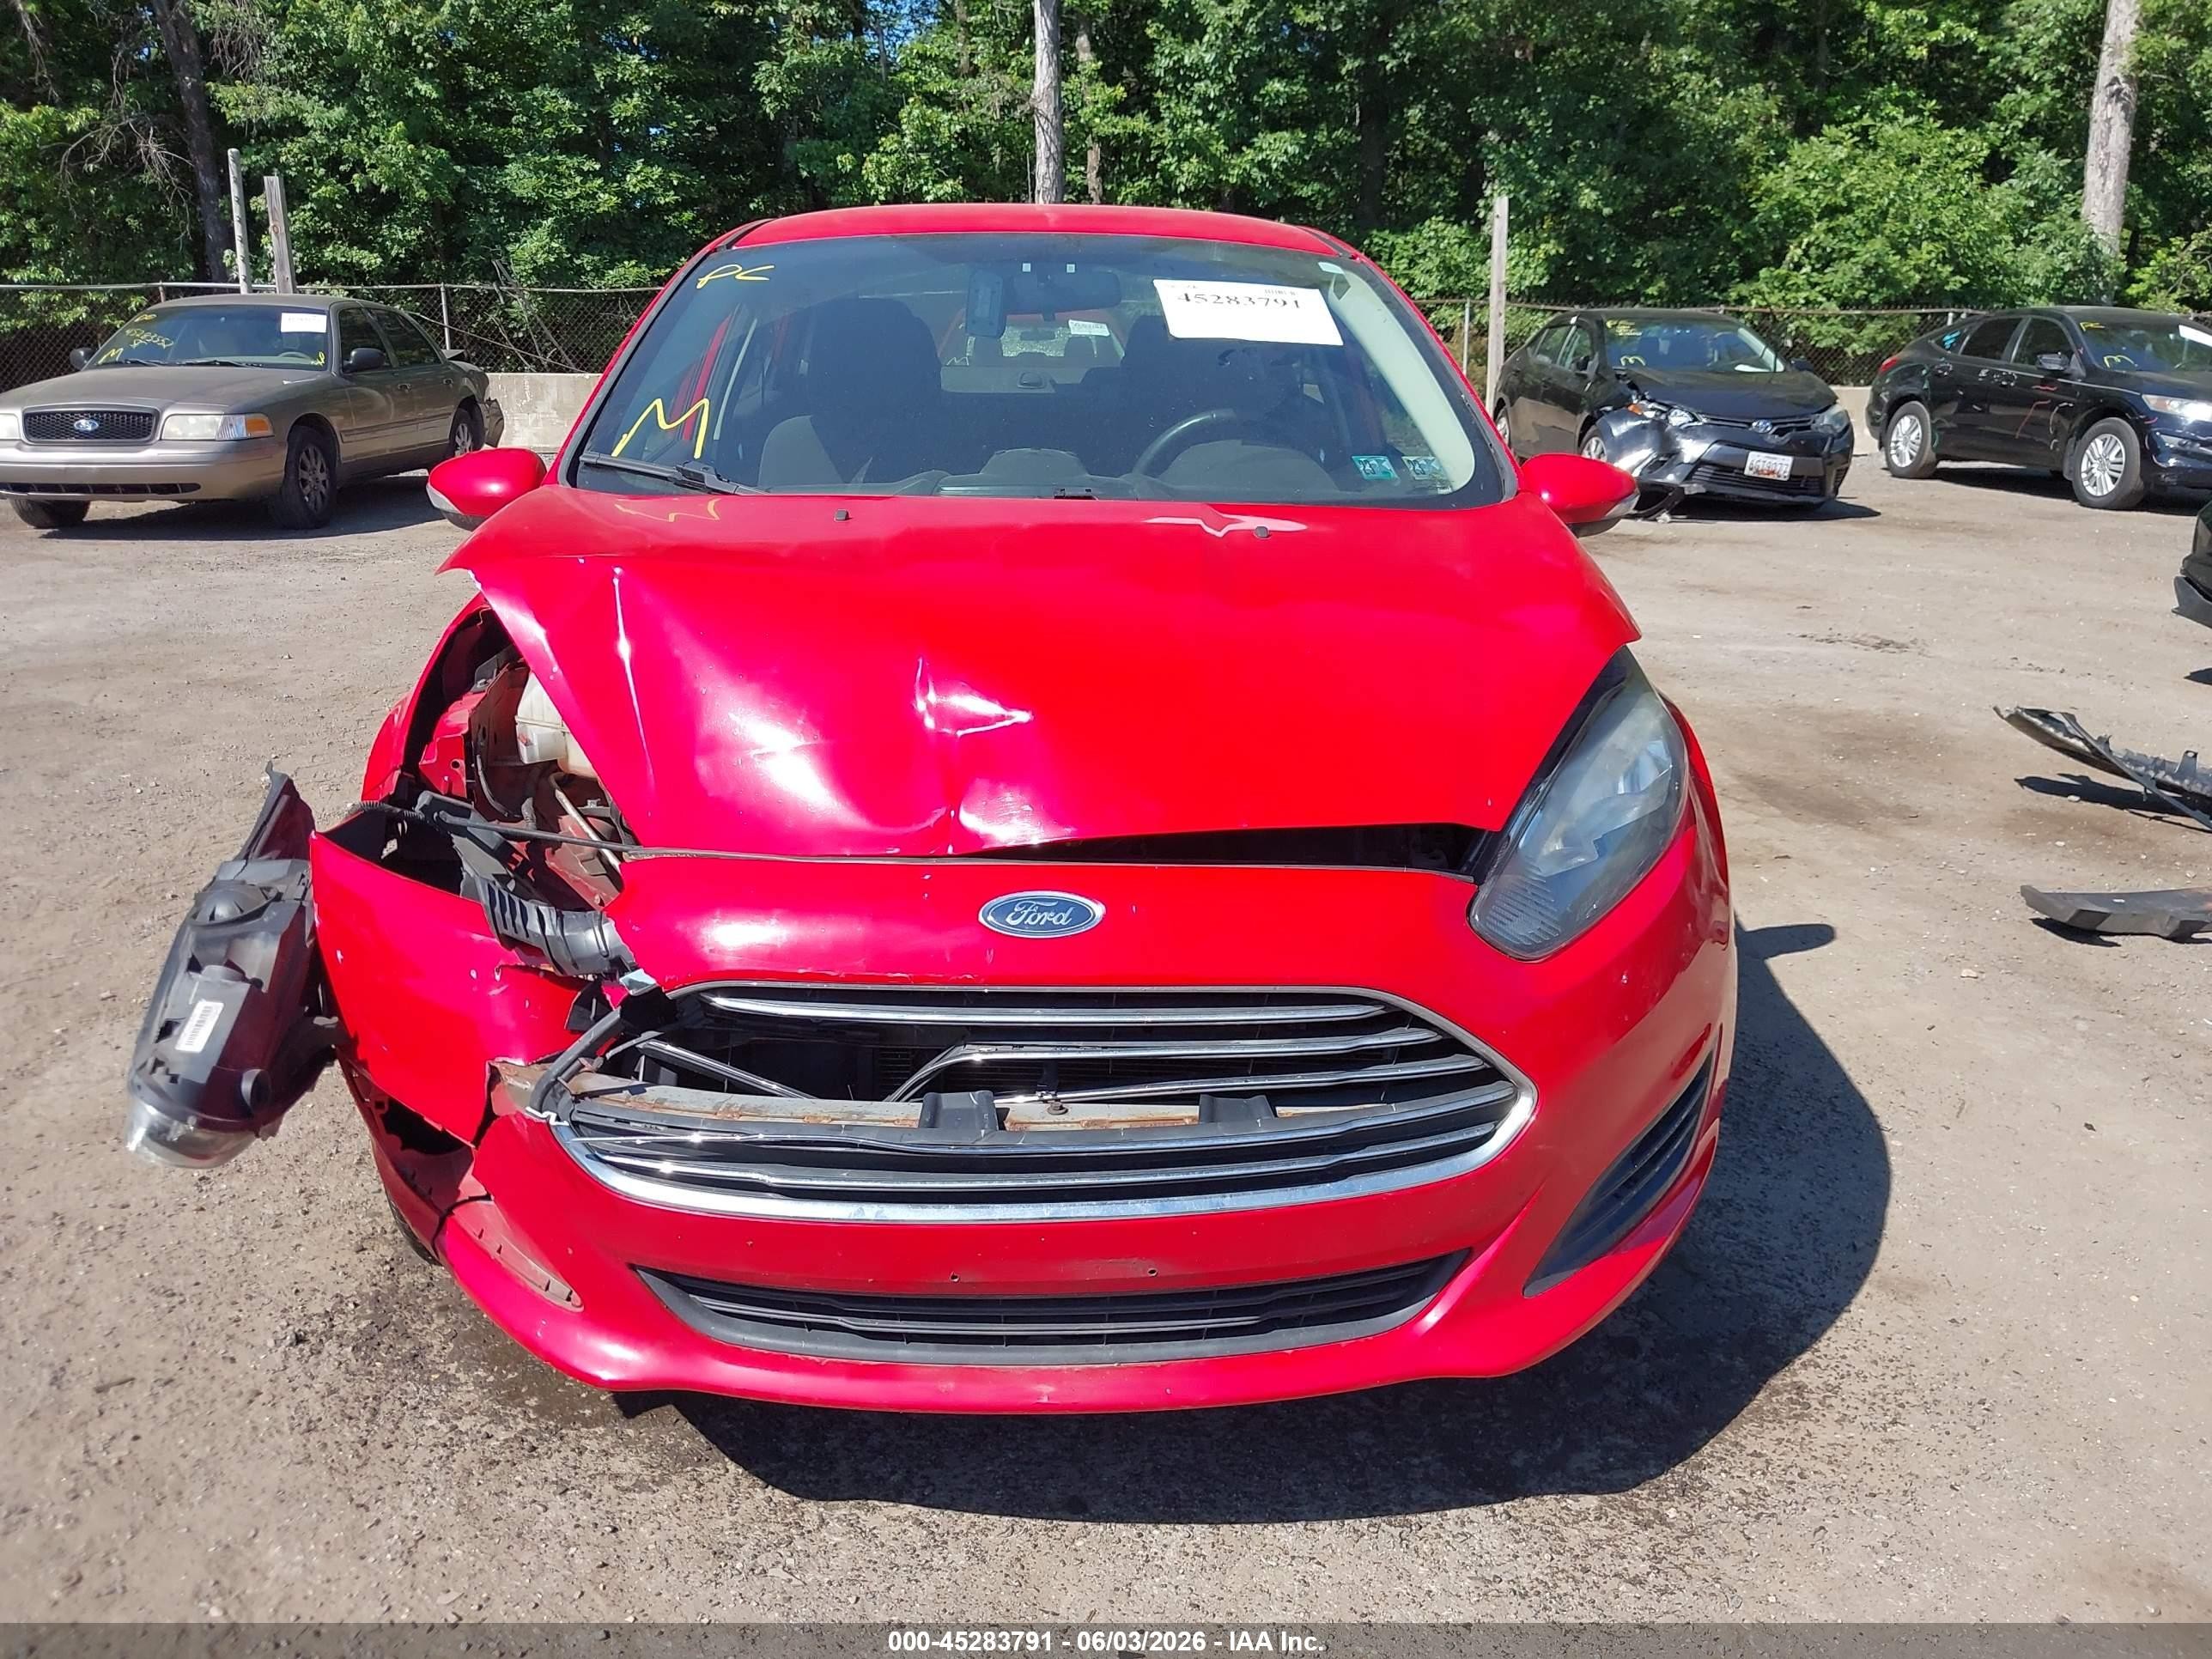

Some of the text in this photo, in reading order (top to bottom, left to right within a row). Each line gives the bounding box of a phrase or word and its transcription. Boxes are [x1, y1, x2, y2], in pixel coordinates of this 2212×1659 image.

[1177, 292, 1301, 309] 45283791
[611, 398, 710, 460] M
[1005, 900, 1074, 926] Ford
